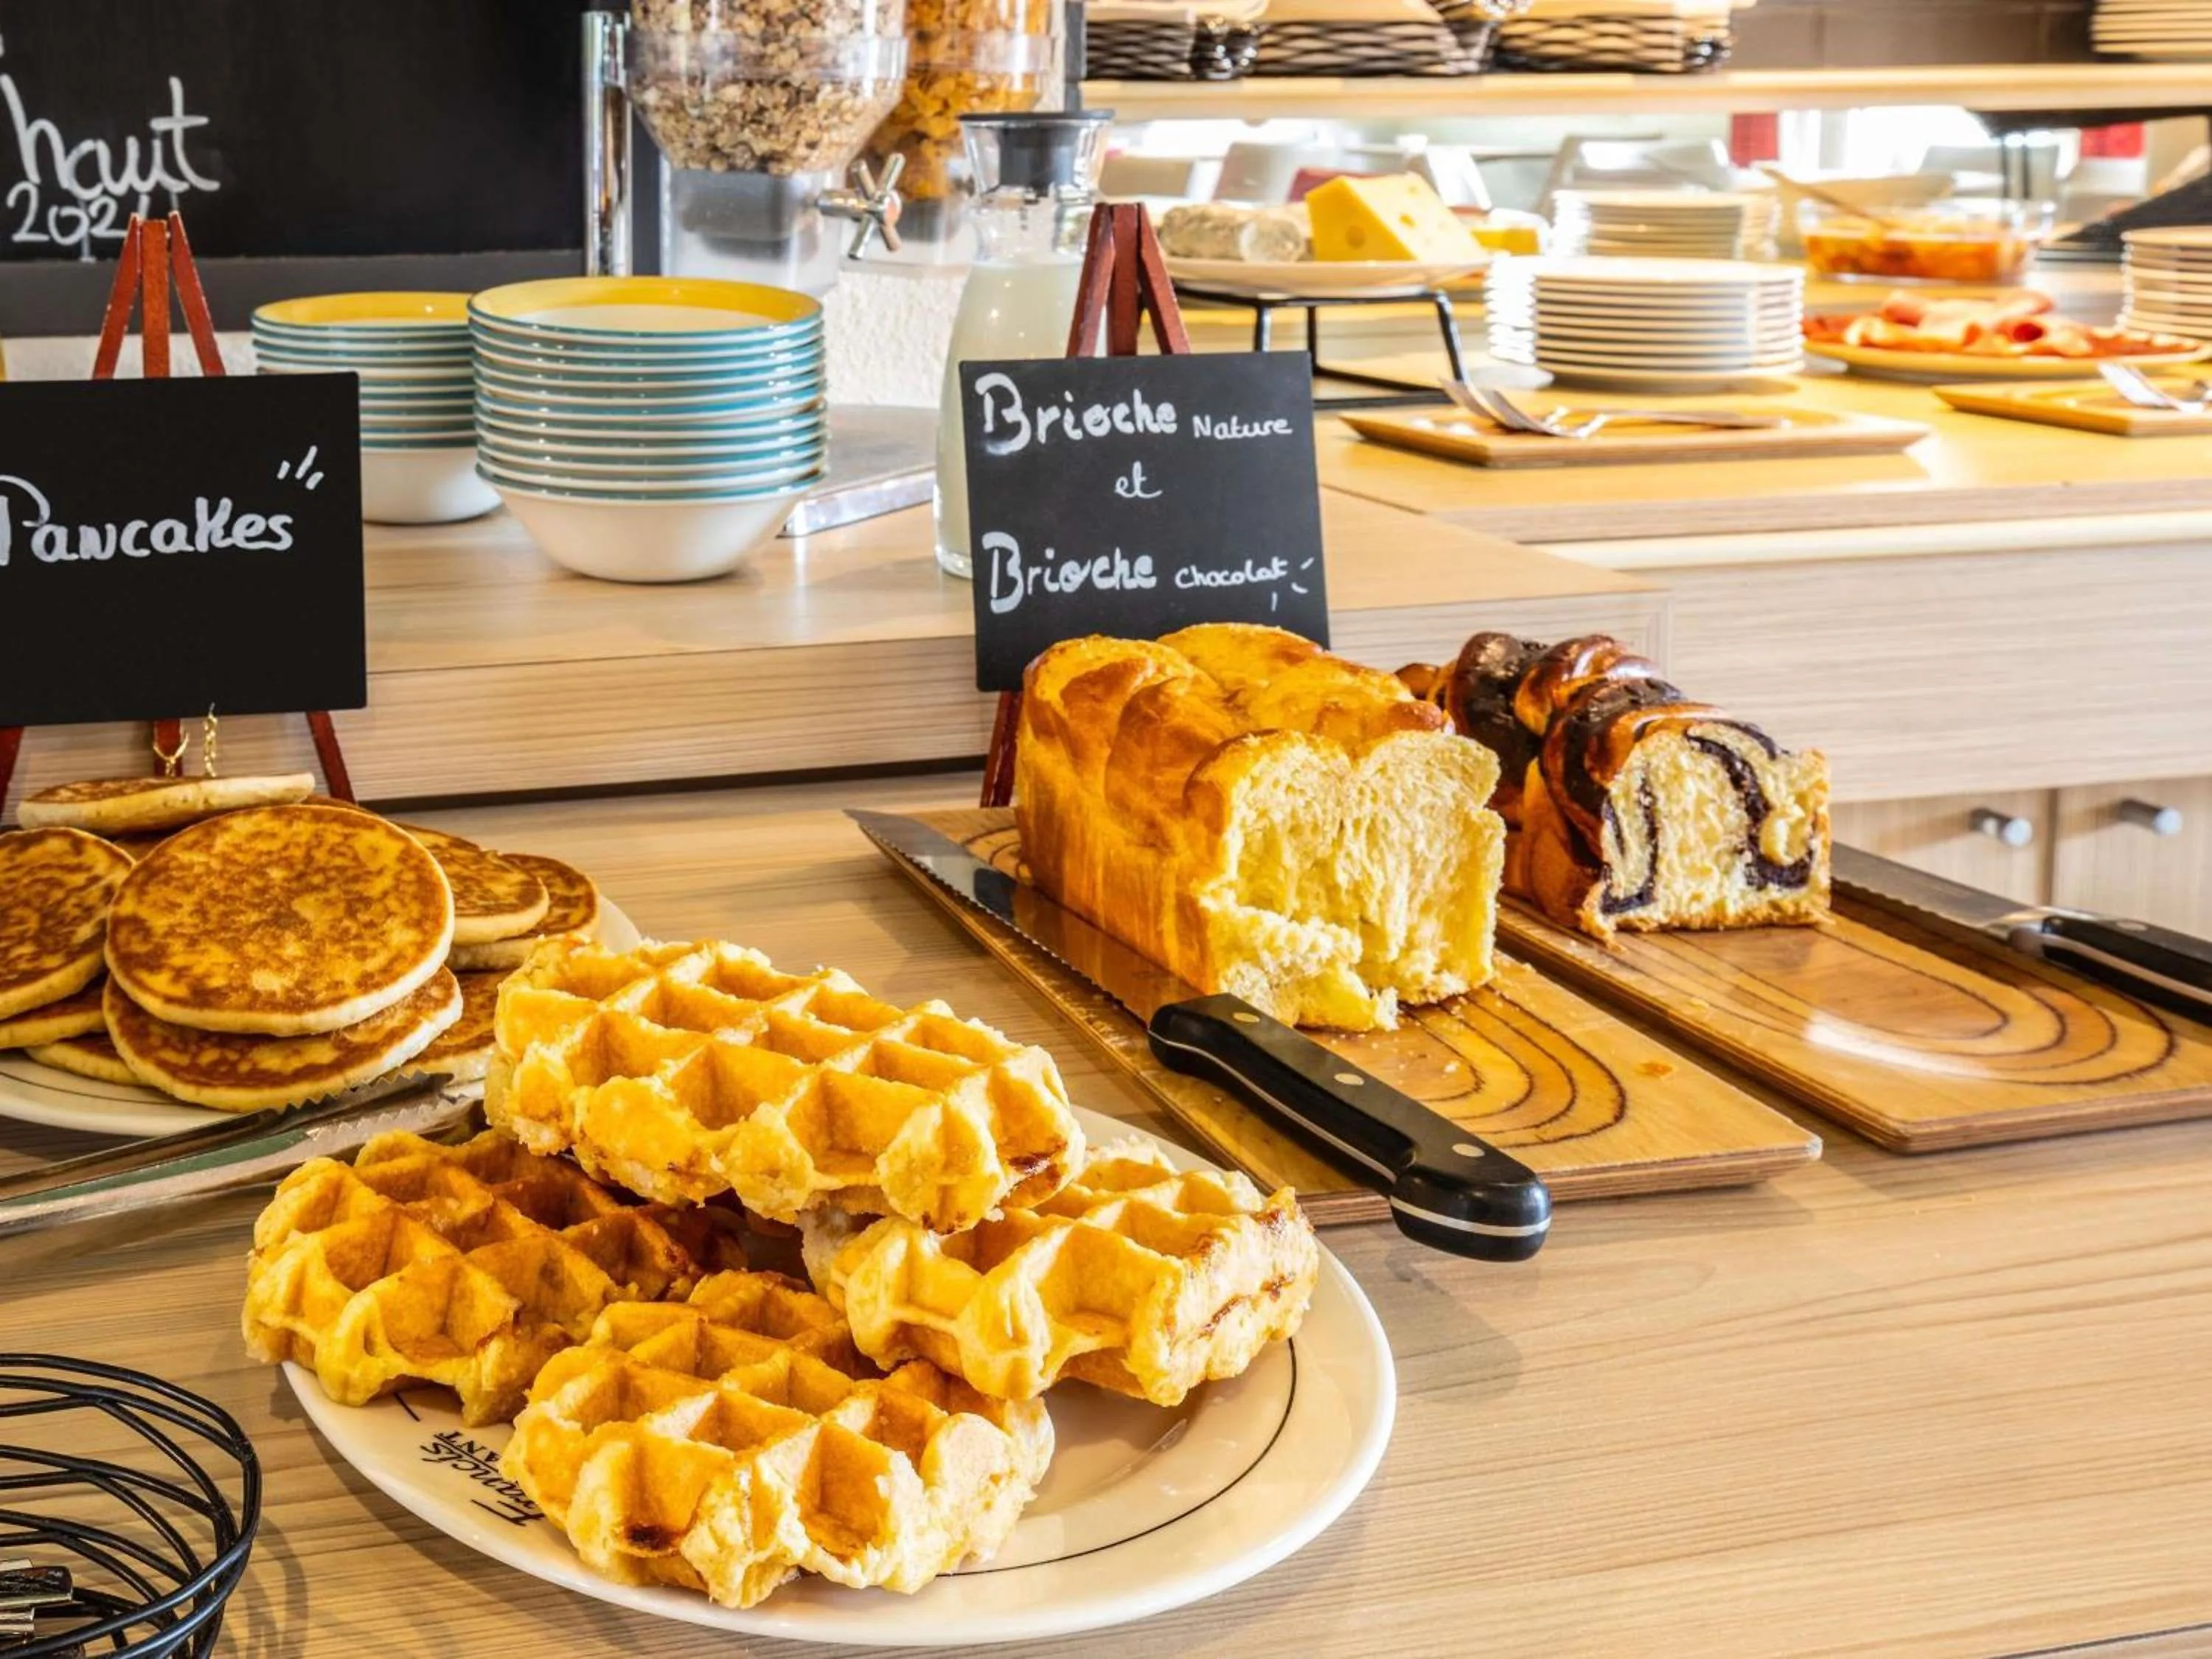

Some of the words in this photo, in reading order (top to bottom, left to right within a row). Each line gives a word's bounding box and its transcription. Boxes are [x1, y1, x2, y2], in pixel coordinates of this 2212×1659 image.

[0, 74, 220, 199] haut
[975, 372, 1178, 455] Brioche
[1193, 414, 1293, 440] Nature
[1115, 460, 1164, 498] et
[981, 531, 1158, 614] Brioche
